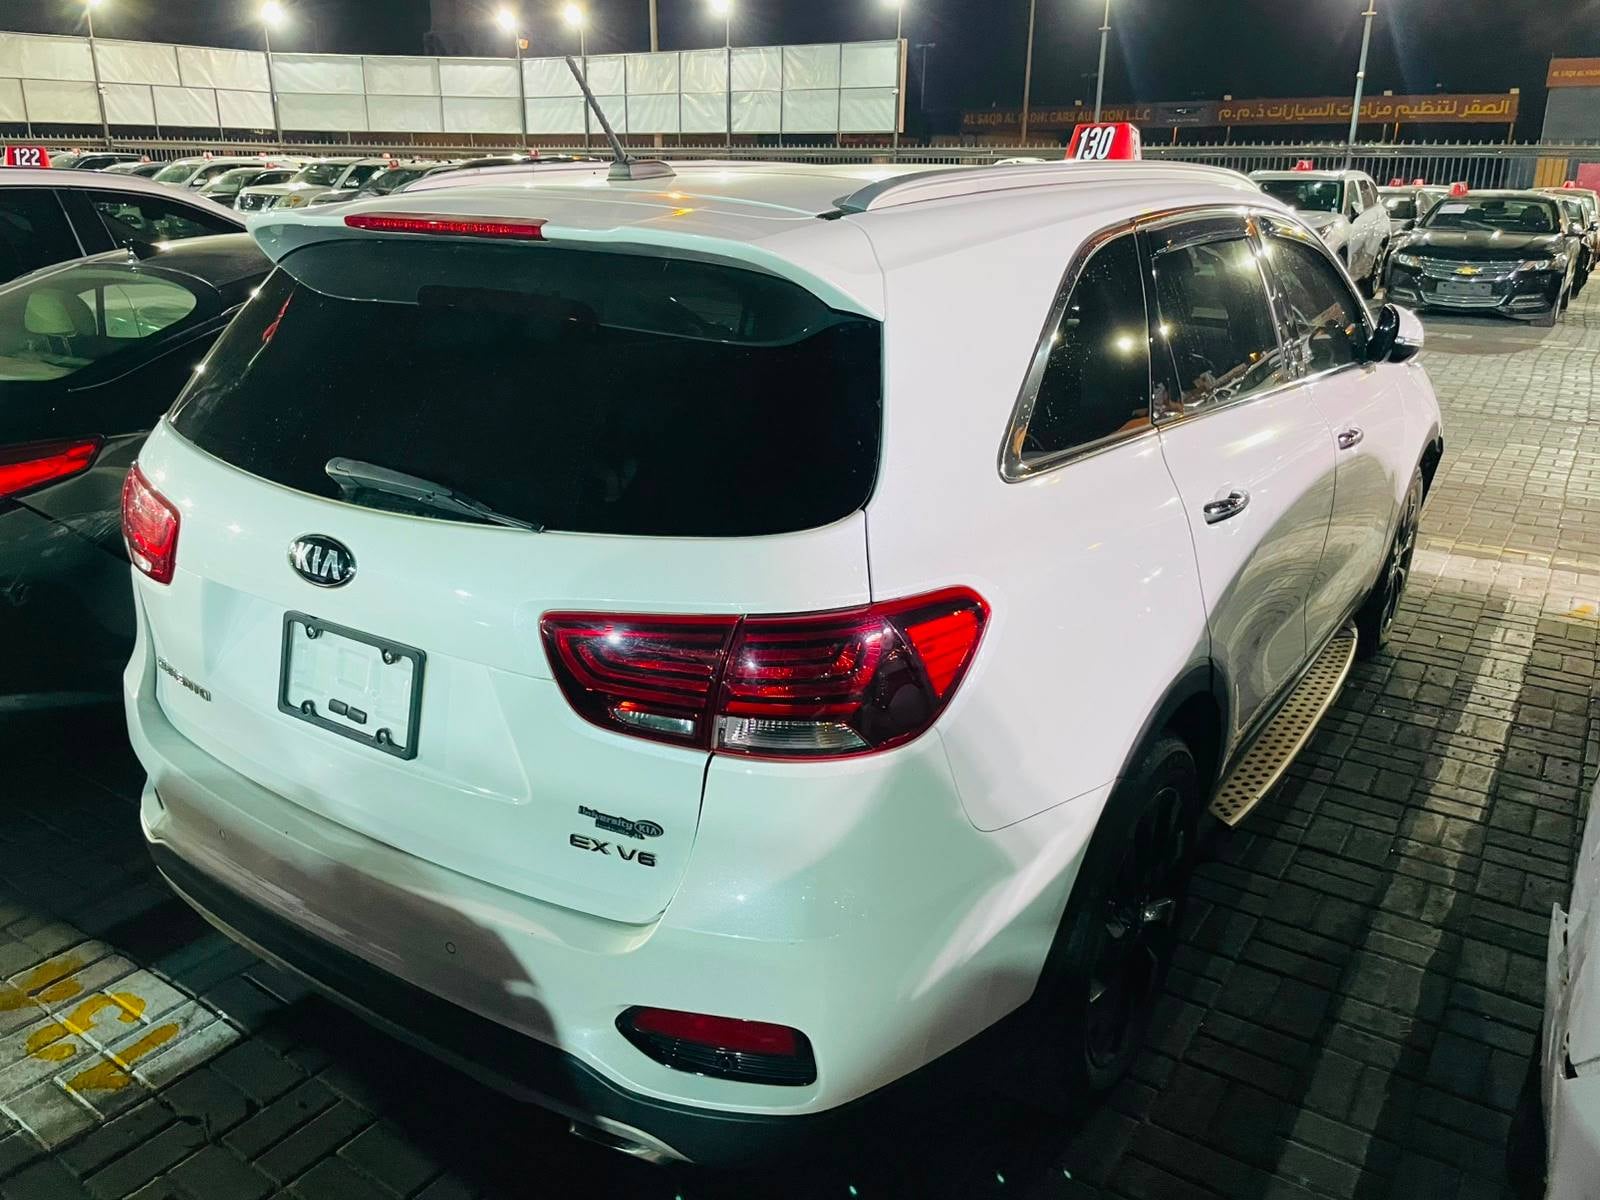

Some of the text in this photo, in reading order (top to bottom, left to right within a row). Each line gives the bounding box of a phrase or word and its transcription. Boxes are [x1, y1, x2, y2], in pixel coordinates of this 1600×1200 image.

[1267, 103, 1334, 121] السيارات
[1395, 100, 1457, 119] لتنظيم
[1459, 99, 1510, 118] الصقر
[1076, 126, 1116, 160] 130
[13, 148, 40, 166] 122
[295, 541, 341, 581] KIA
[570, 834, 657, 867] EX V6
